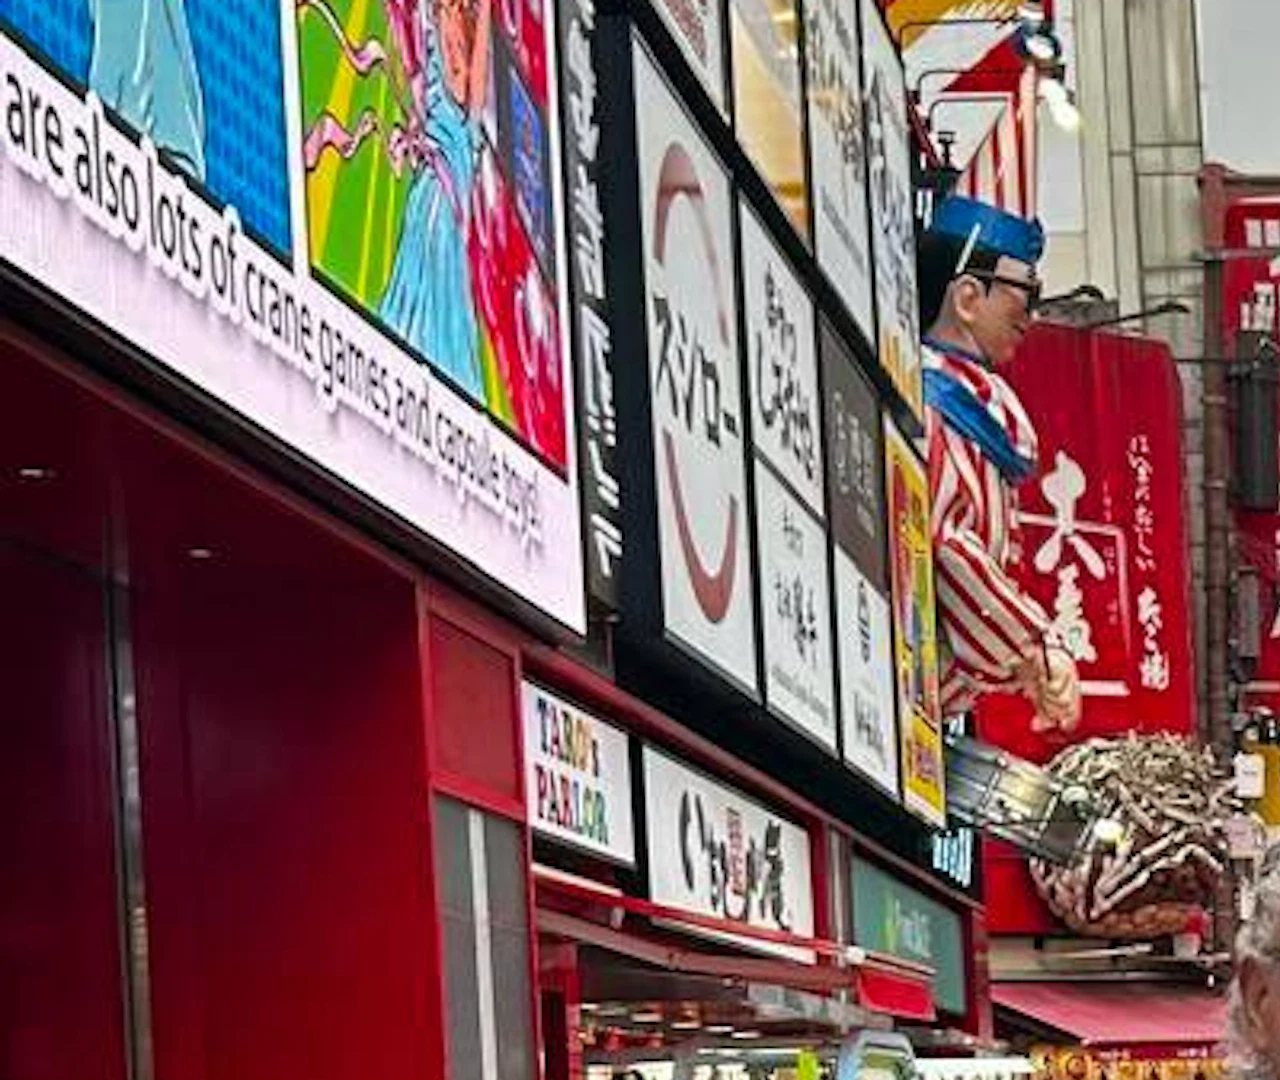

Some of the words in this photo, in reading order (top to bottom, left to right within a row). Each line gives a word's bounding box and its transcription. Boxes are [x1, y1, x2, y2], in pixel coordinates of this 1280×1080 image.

[5, 70, 64, 178] are
[73, 98, 140, 232] also
[147, 146, 203, 279] lots
[209, 214, 242, 305] of
[243, 260, 313, 360] crane
[317, 316, 392, 416] games
[393, 370, 433, 452] and
[434, 414, 501, 502] capsule
[567, 0, 623, 578] おれビル
[652, 294, 741, 447] スシロー
[535, 764, 611, 847] PARLOR
